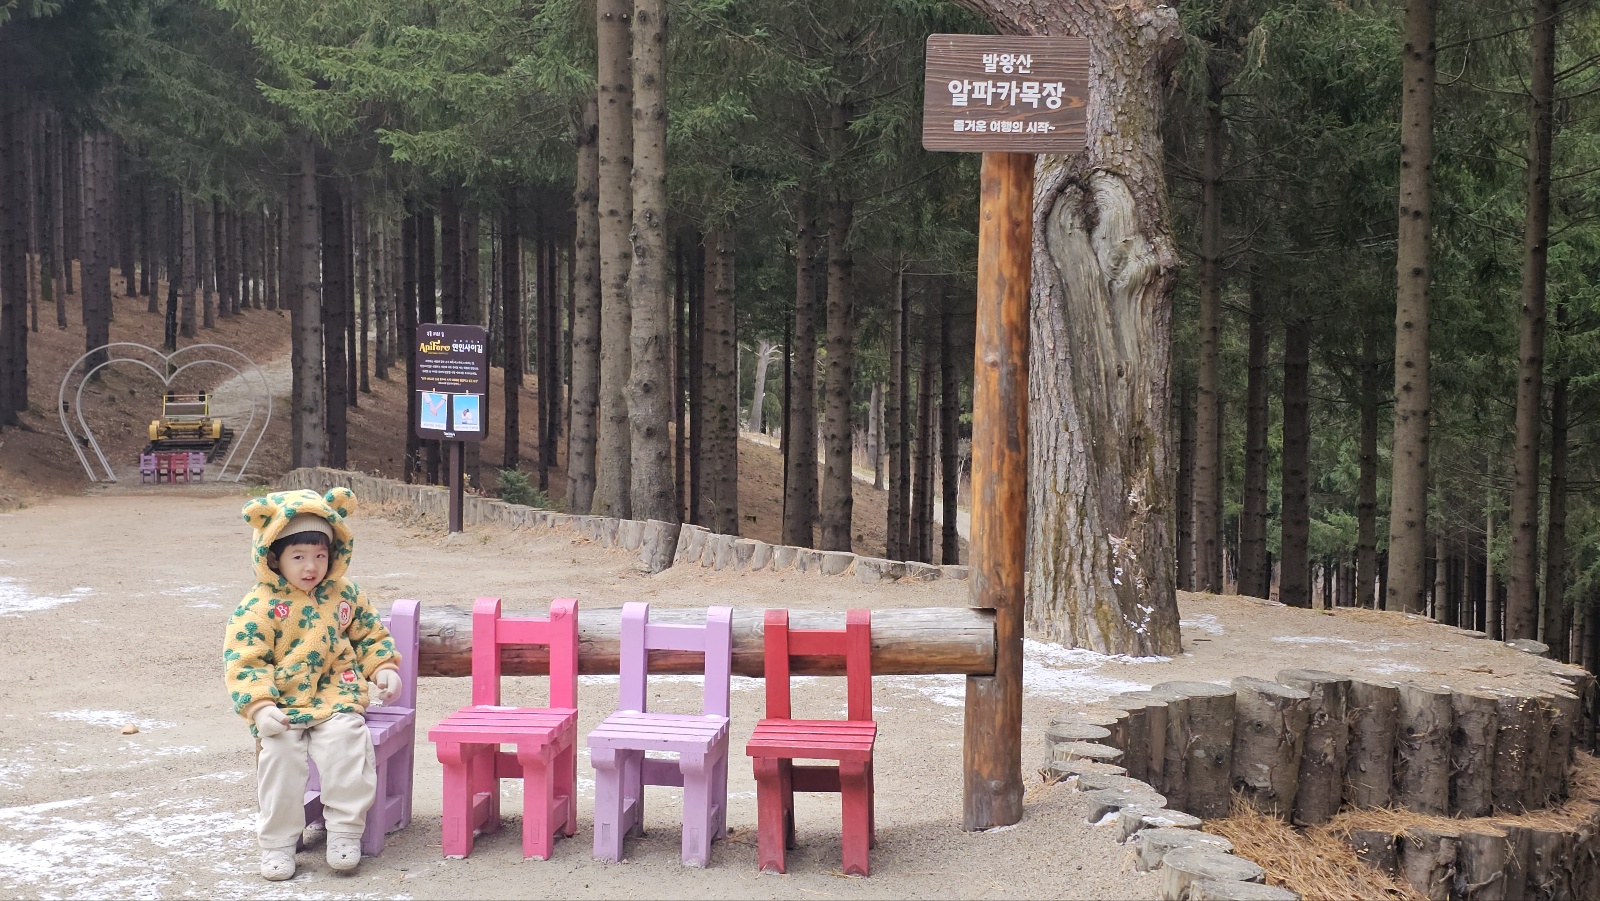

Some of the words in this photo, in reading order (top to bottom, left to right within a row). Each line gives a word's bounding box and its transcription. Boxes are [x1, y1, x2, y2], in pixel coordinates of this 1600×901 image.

[983, 54, 1033, 74] 발왕산
[948, 80, 1066, 109] 알파카목장
[953, 120, 986, 132] 즐거운
[990, 121, 1023, 133] 여행의
